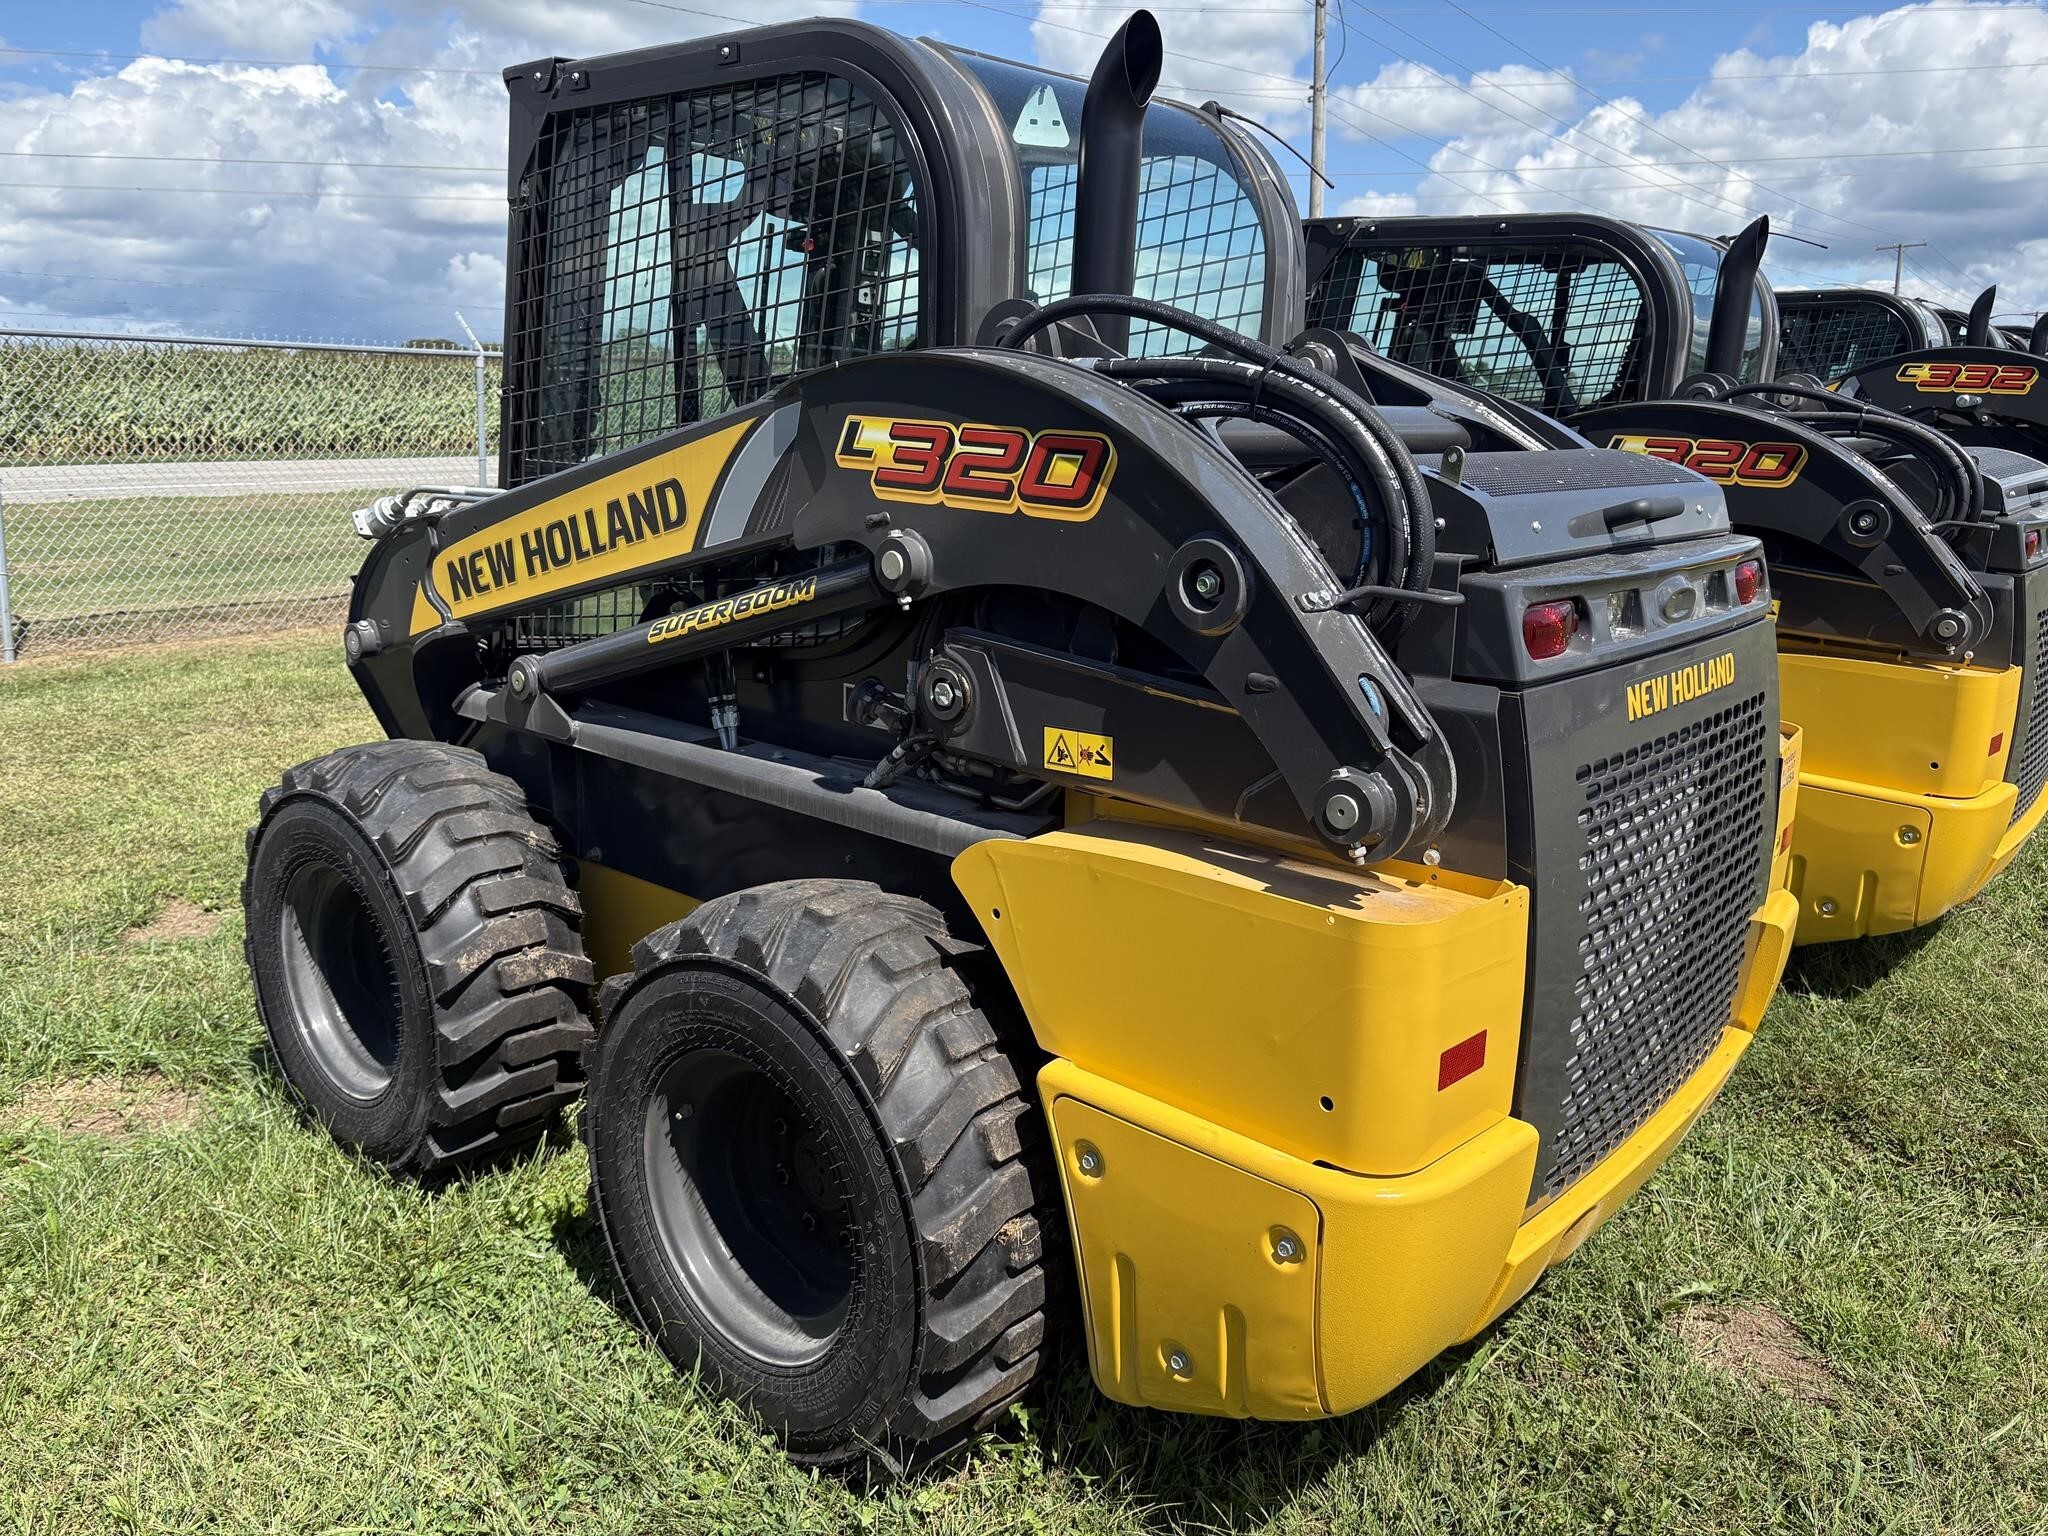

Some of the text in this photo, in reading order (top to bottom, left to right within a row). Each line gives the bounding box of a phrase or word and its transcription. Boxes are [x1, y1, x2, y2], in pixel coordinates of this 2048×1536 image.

[1896, 363, 2039, 394] C332
[836, 415, 1118, 521] L320
[446, 476, 688, 602] NEW HOLLAND
[648, 575, 817, 643] SUPER BOOM
[1626, 652, 1736, 722] NEW HOLLAND
